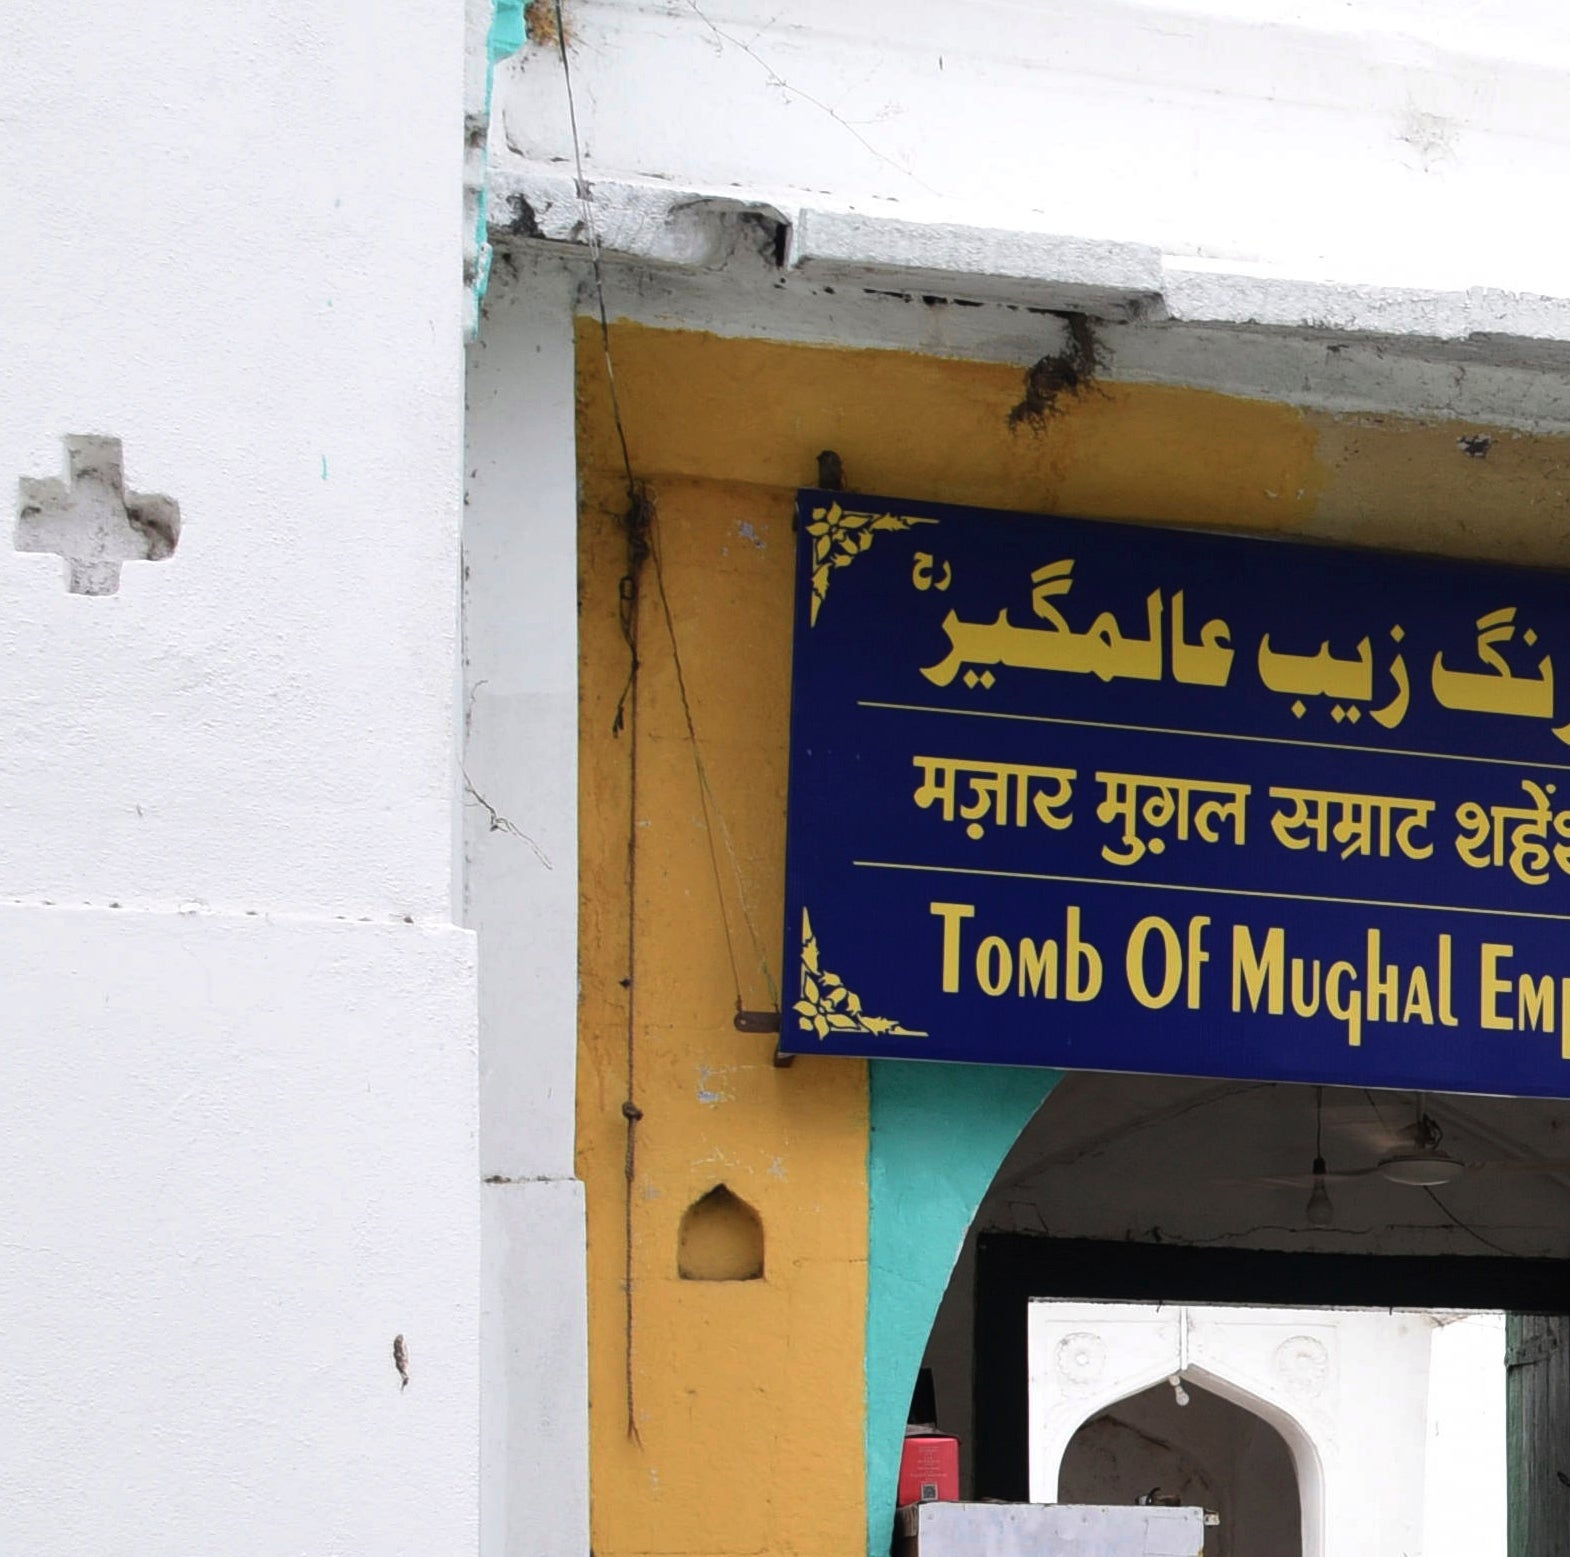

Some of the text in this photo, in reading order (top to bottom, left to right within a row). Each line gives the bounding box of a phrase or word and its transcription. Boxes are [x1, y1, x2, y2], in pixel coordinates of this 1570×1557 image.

[1257, 625, 1410, 729] زیب
[913, 756, 1077, 840] मज़ार
[1269, 786, 1436, 860] सम्राट
[930, 902, 1103, 1002] Tomb
[1126, 915, 1210, 1010] Of
[1231, 925, 1458, 1046] Mughal
